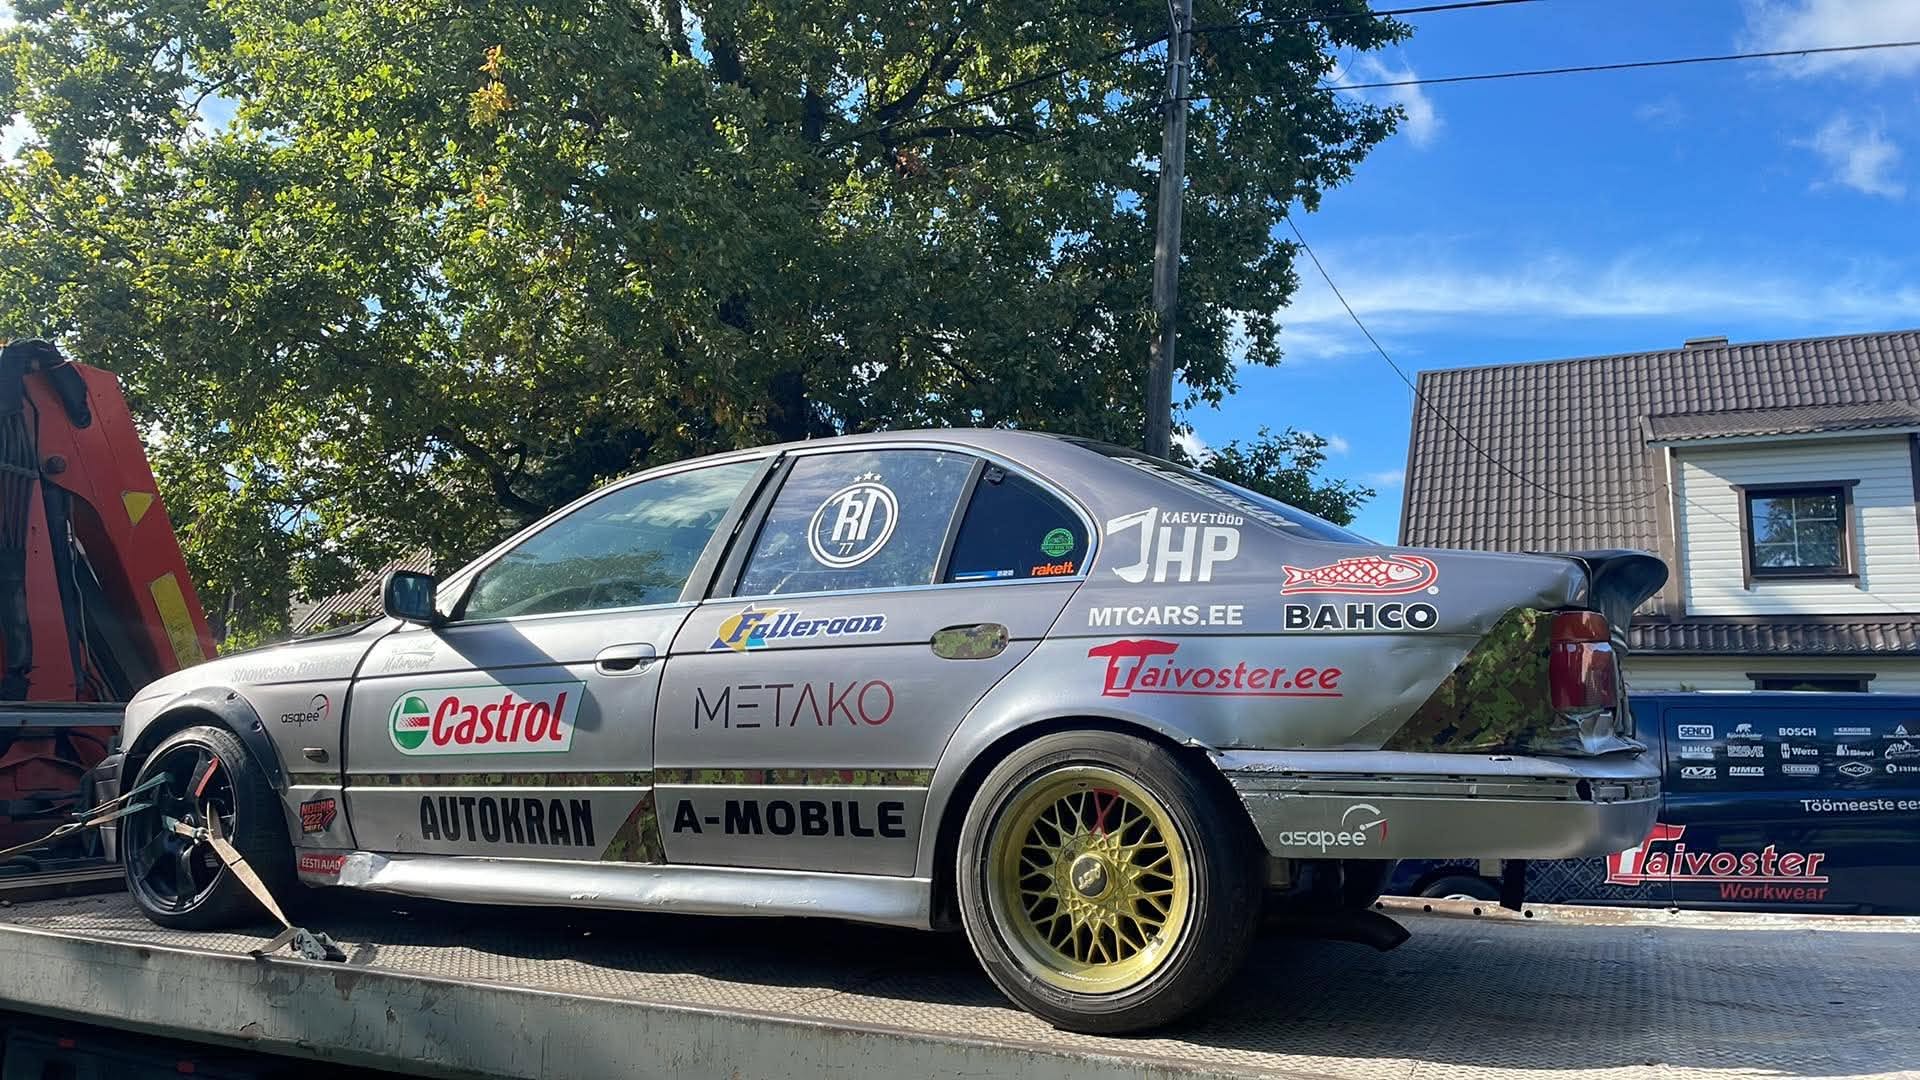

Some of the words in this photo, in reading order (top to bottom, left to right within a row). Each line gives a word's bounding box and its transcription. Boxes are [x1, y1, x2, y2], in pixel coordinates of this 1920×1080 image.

[1162, 511, 1244, 526] KAEVETÖÖD
[838, 542, 854, 555] 77
[1088, 605, 1243, 626] MTCARS.EE
[1284, 603, 1439, 630] BAHCO
[726, 611, 887, 643] Falleroon
[1088, 639, 1343, 697] Taivoster.ee
[694, 679, 895, 729] METAKO
[280, 710, 320, 728] asap.ee
[432, 691, 568, 746] Castrol
[1680, 727, 1711, 737] SENCO
[1779, 728, 1816, 736] BOSCH
[1791, 746, 1818, 755] Wera
[1800, 800, 1894, 812] Töömeeste
[420, 796, 596, 847] AUTOKRAN
[673, 800, 906, 838] A-MOBILE
[1279, 830, 1366, 853] asap.ee
[1719, 883, 1828, 900] Workwear
